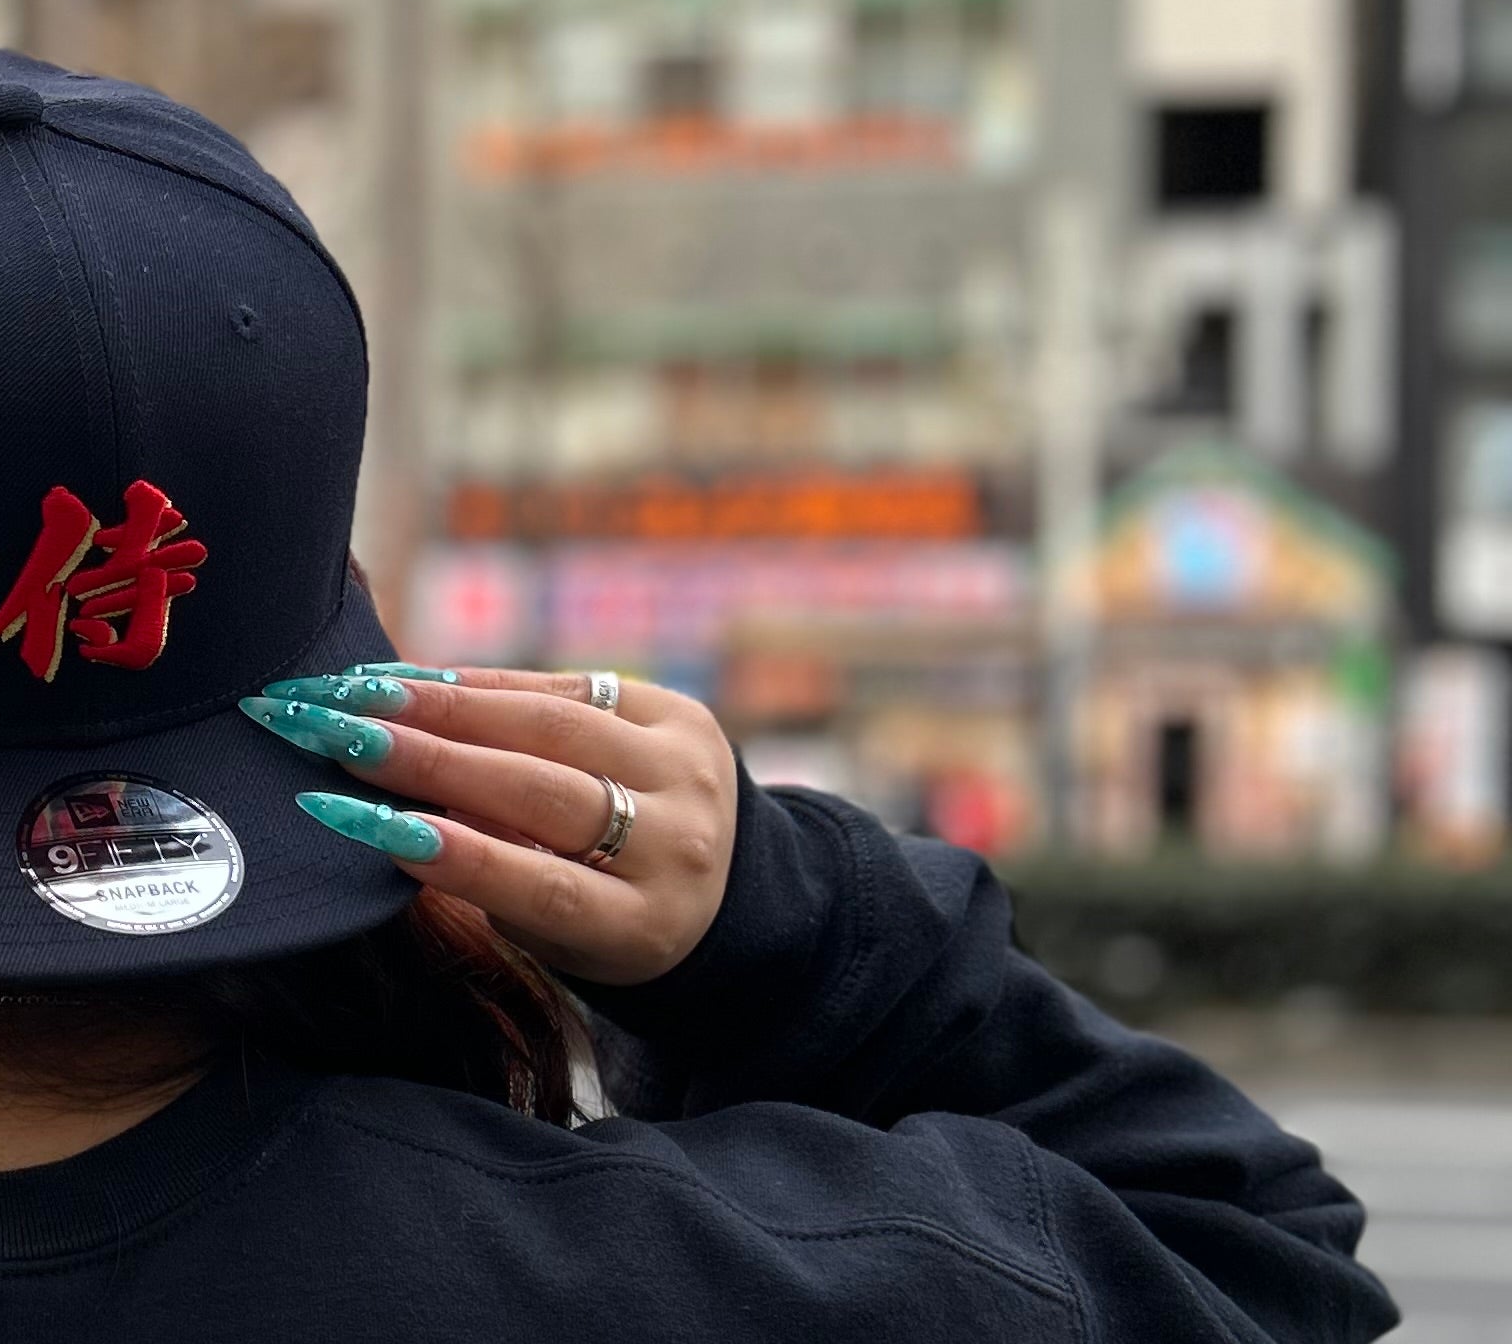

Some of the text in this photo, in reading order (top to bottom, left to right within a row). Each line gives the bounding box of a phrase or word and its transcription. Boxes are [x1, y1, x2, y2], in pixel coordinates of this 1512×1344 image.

[117, 797, 151, 809] NEW
[121, 806, 154, 819] ERA
[95, 879, 201, 903] SNAPBACK
